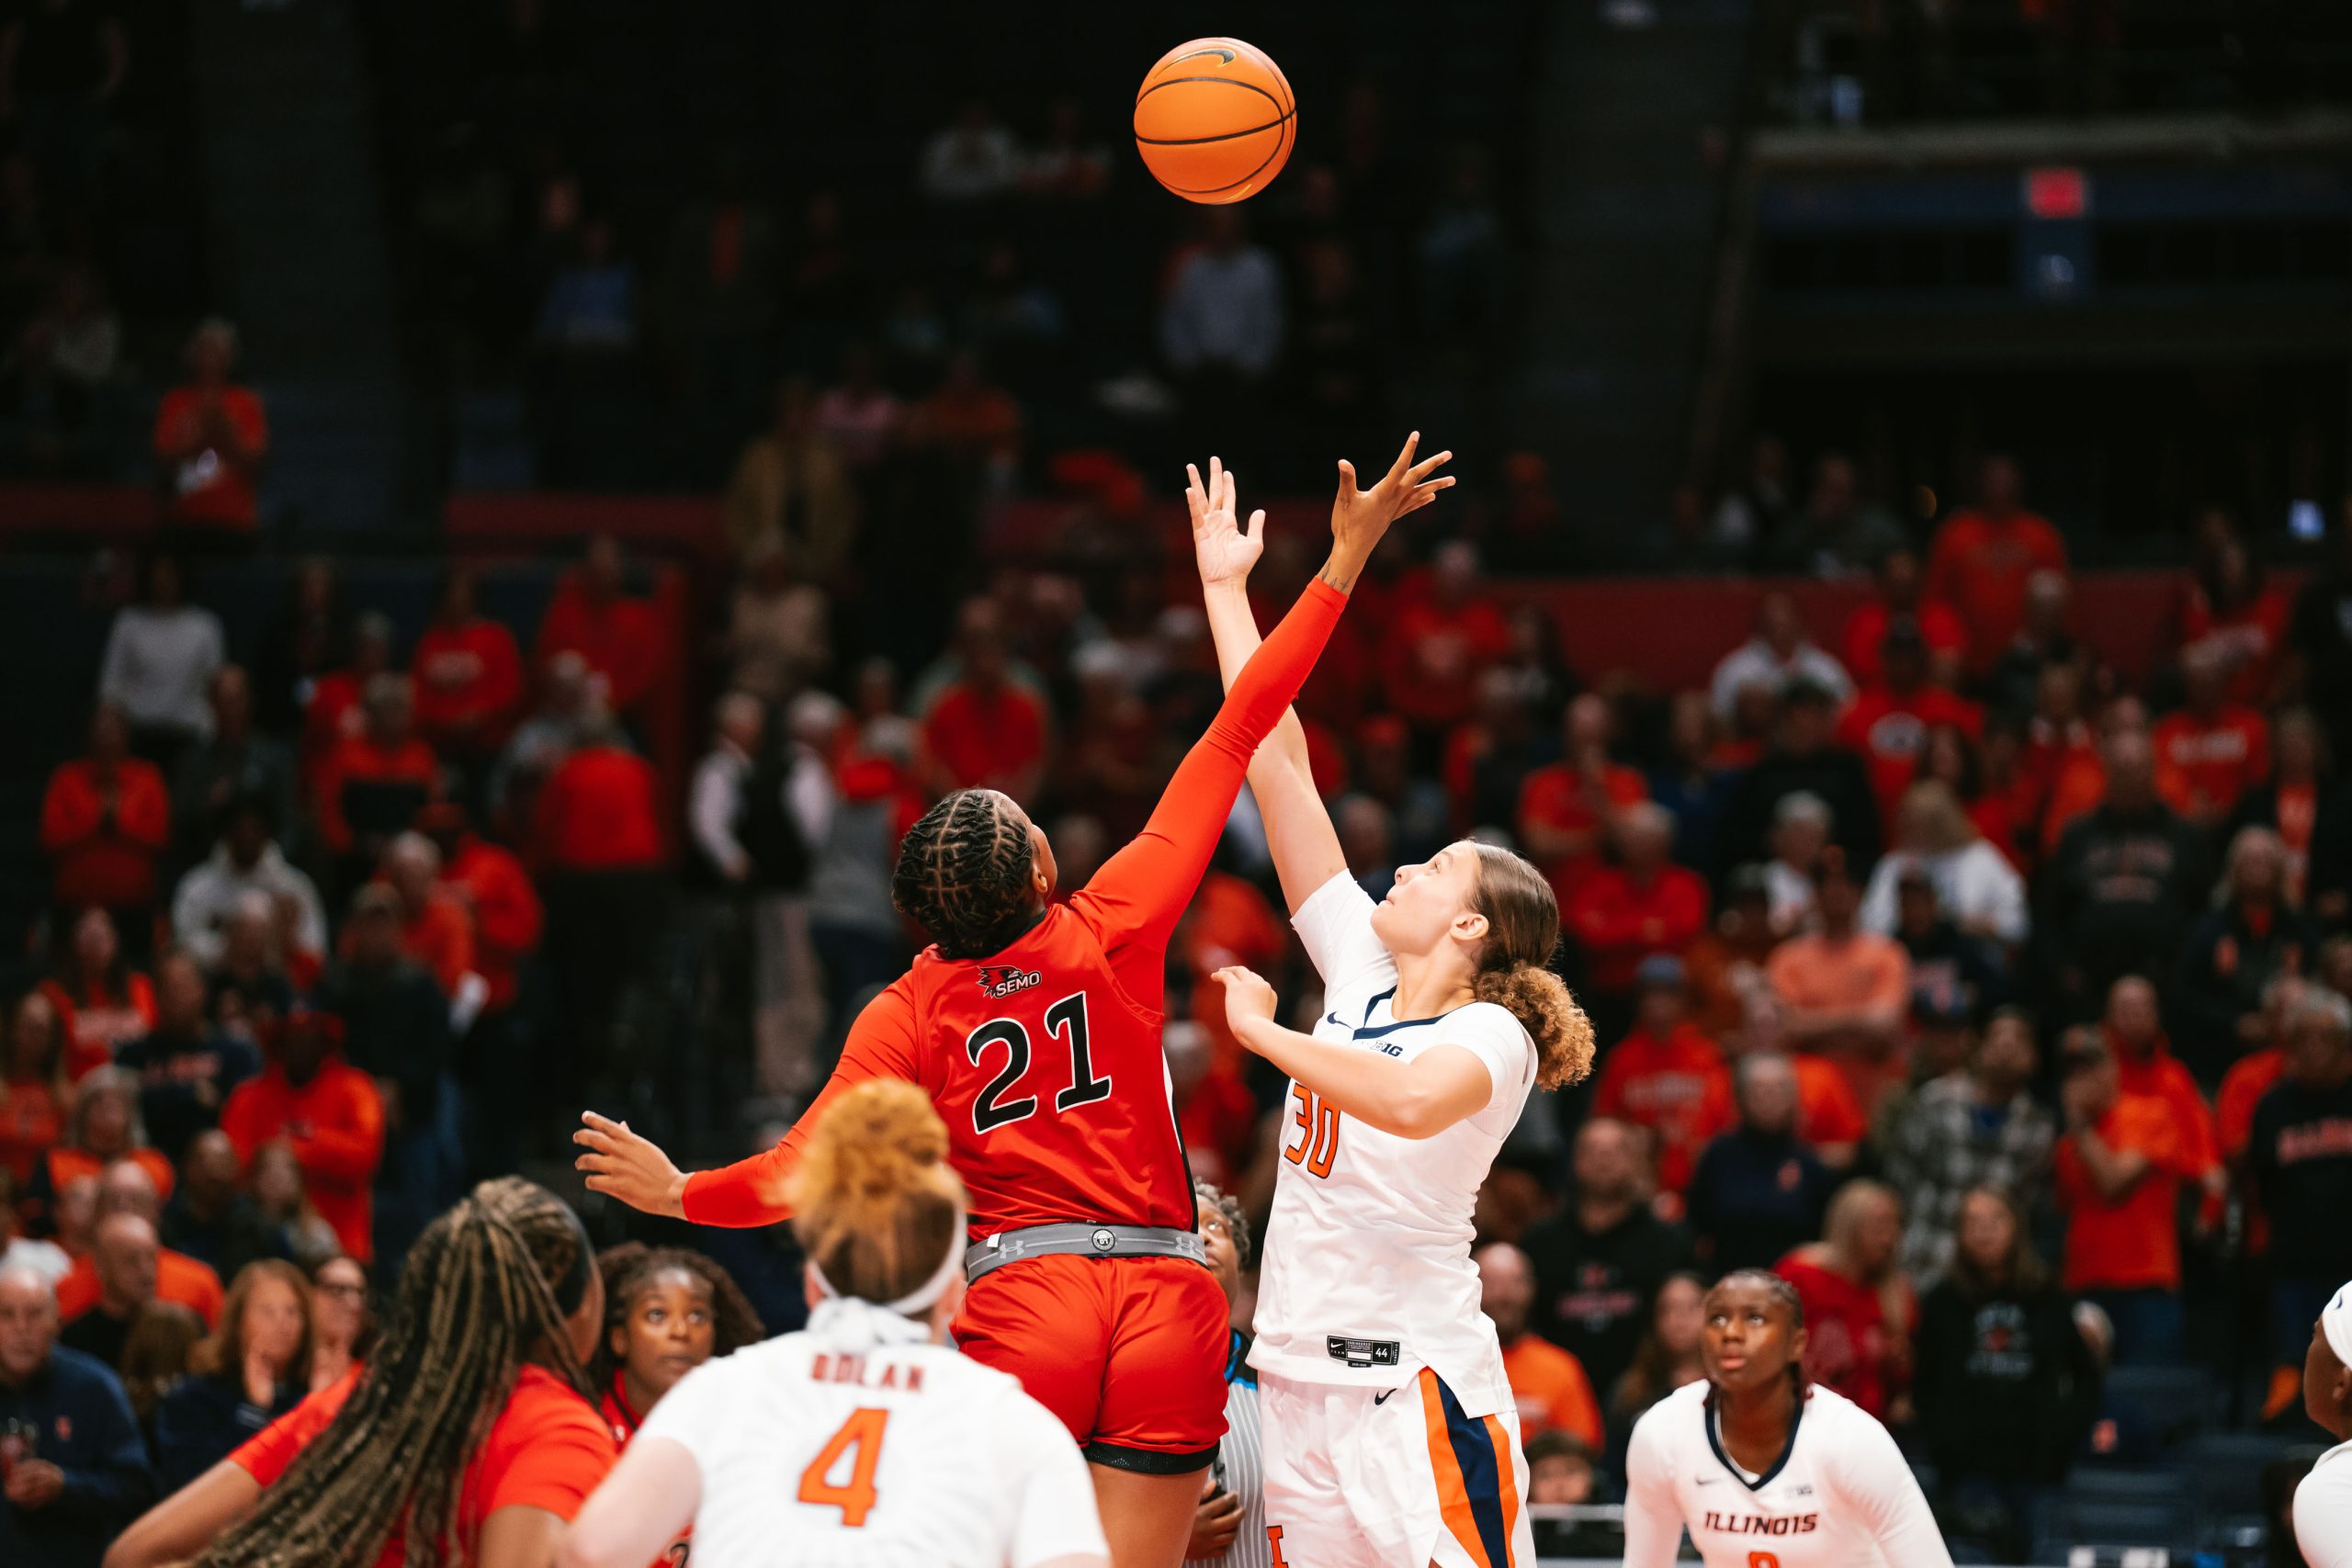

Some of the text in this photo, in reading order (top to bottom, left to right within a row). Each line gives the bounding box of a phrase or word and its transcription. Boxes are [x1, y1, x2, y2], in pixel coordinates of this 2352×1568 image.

[995, 971, 1041, 997] SEMO
[966, 990, 1112, 1135] 21
[1283, 1082, 1341, 1179] 30
[1375, 1348, 1388, 1358] 44
[796, 1406, 890, 1528] 4
[1705, 1511, 1818, 1536] ILLINOIS
